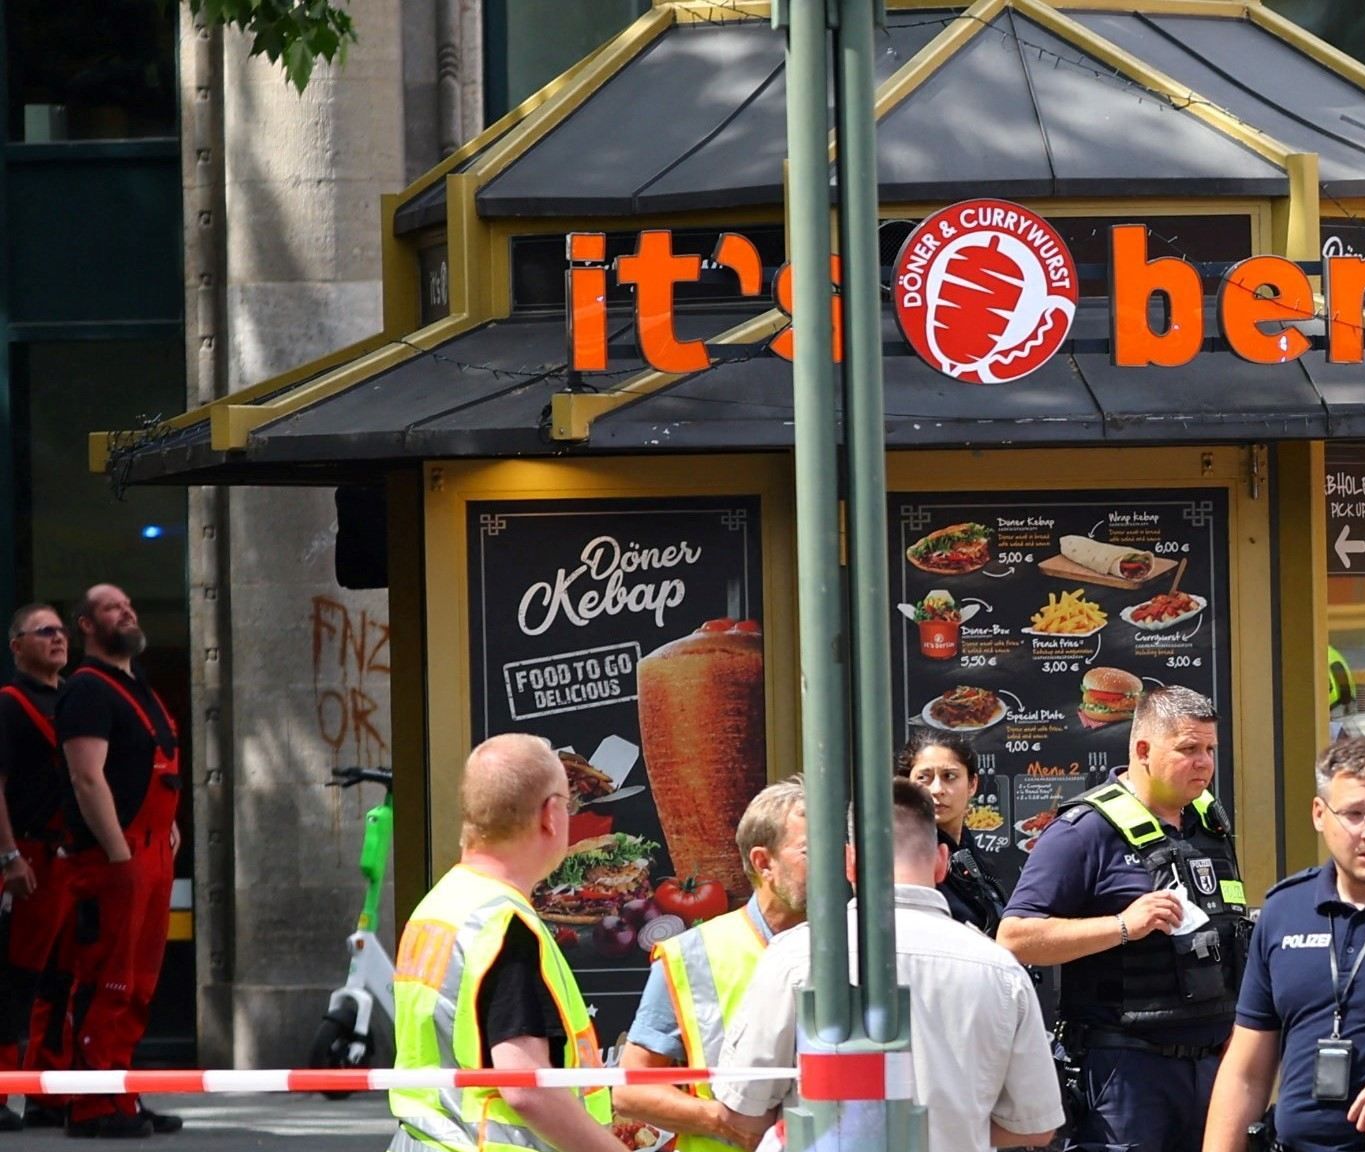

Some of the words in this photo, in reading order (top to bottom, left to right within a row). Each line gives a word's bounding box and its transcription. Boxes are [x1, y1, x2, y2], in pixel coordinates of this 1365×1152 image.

[899, 233, 940, 308] DÖNER
[939, 220, 958, 239] &
[960, 207, 1070, 289] CURRYWURST
[1331, 502, 1353, 518] PICK
[1155, 541, 1179, 554] 6,00
[581, 536, 701, 580] Döner
[998, 551, 1022, 564] 5,00
[518, 568, 685, 636] Kebap
[1042, 661, 1067, 672] 3,00
[1166, 656, 1191, 667] 3,00
[516, 663, 572, 693] FOOD
[573, 658, 600, 682] TO
[605, 653, 632, 677] GO
[534, 679, 621, 708] DELICIOUS
[1041, 710, 1065, 720] Plate
[1027, 762, 1066, 776] Menu
[1070, 763, 1080, 776] 2
[1282, 933, 1331, 949] POLIZEI
